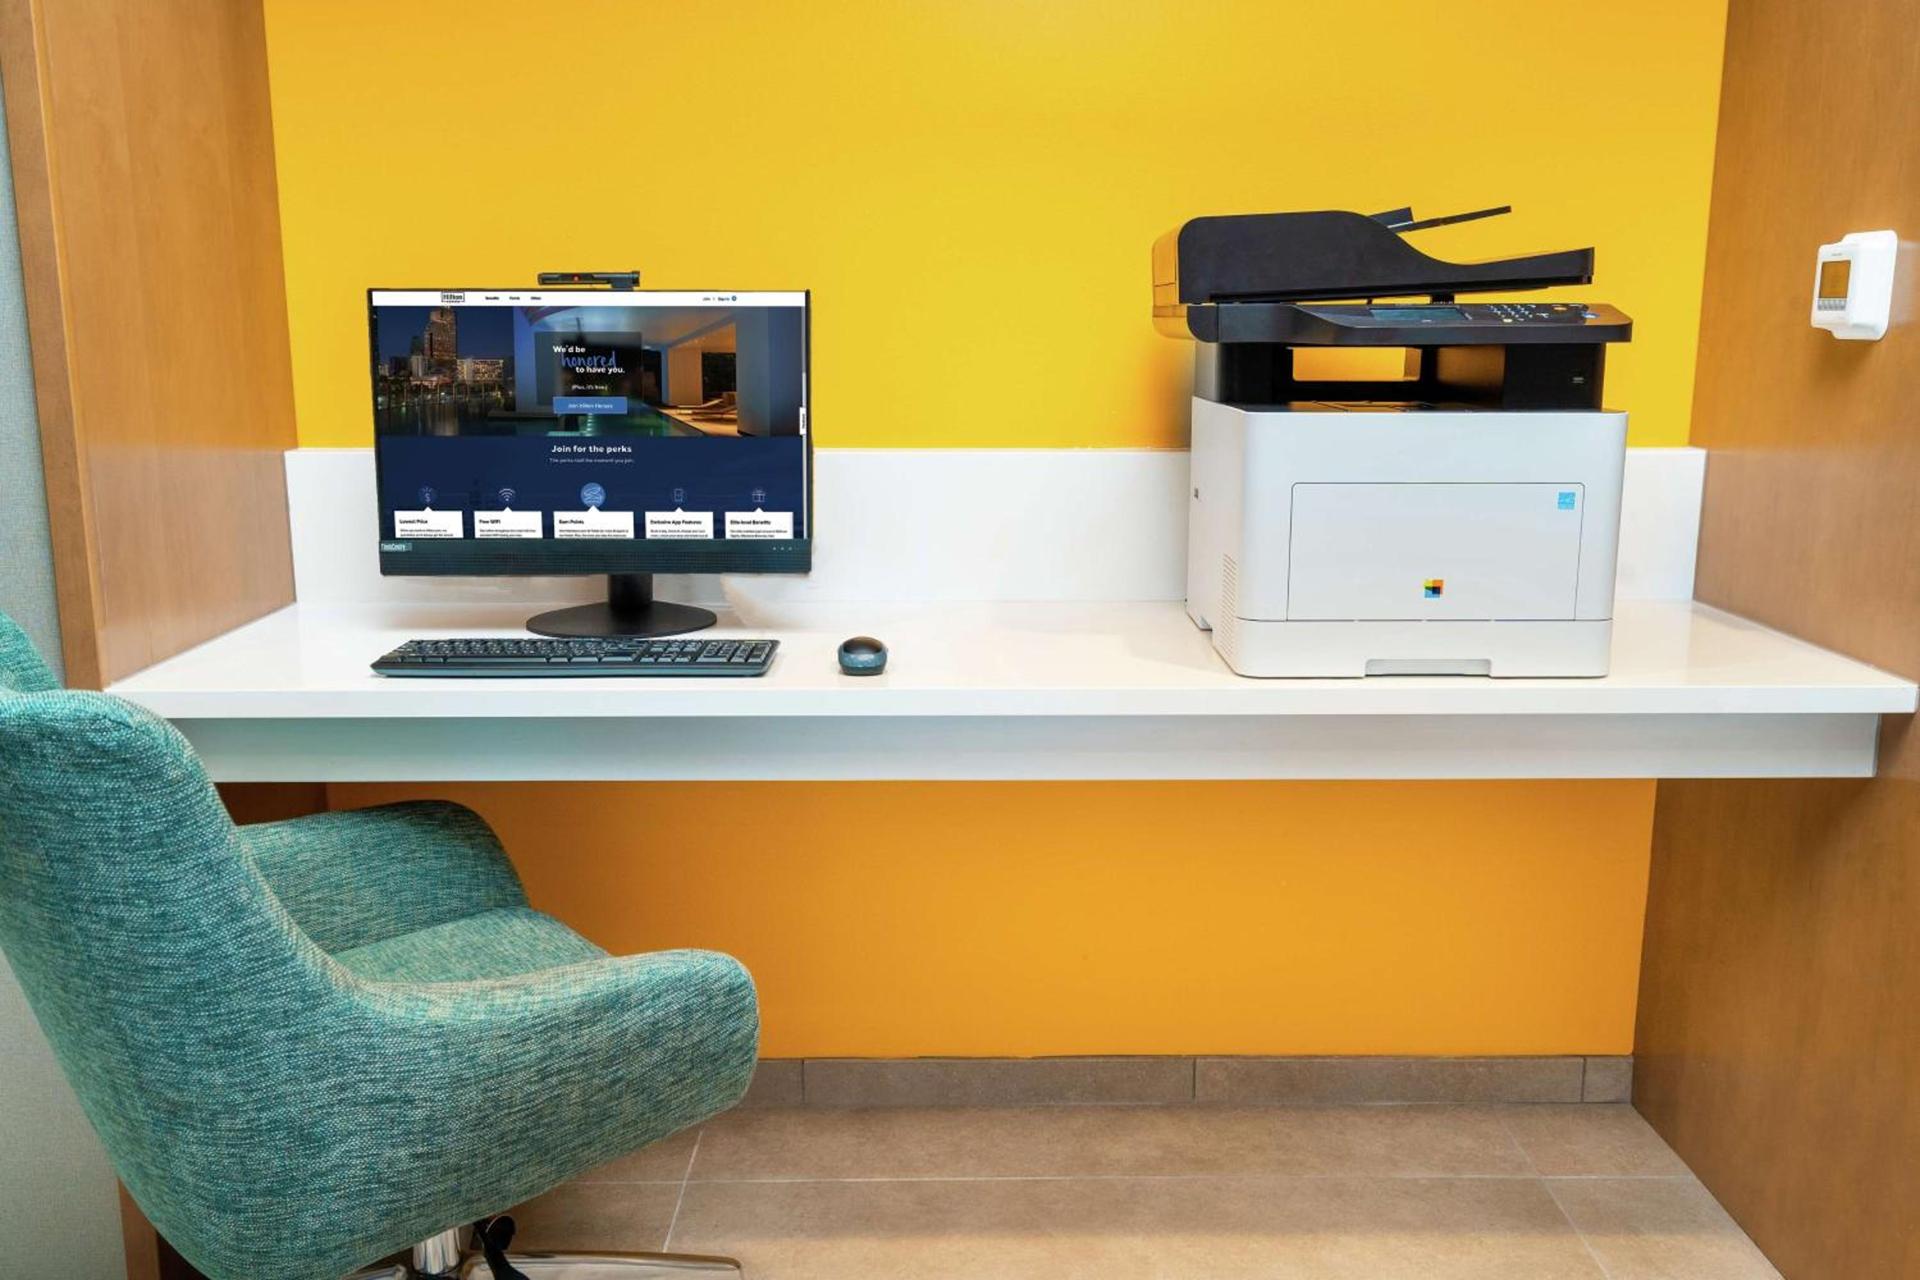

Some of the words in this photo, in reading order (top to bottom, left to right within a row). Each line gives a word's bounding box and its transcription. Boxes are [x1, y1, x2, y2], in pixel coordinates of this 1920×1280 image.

[552, 345, 574, 353] We'd
[575, 345, 586, 353] be
[560, 350, 617, 369] honored
[607, 367, 625, 375] you.
[552, 445, 571, 453] Join
[573, 445, 586, 453] for
[589, 445, 605, 453] the
[606, 445, 632, 454] perks
